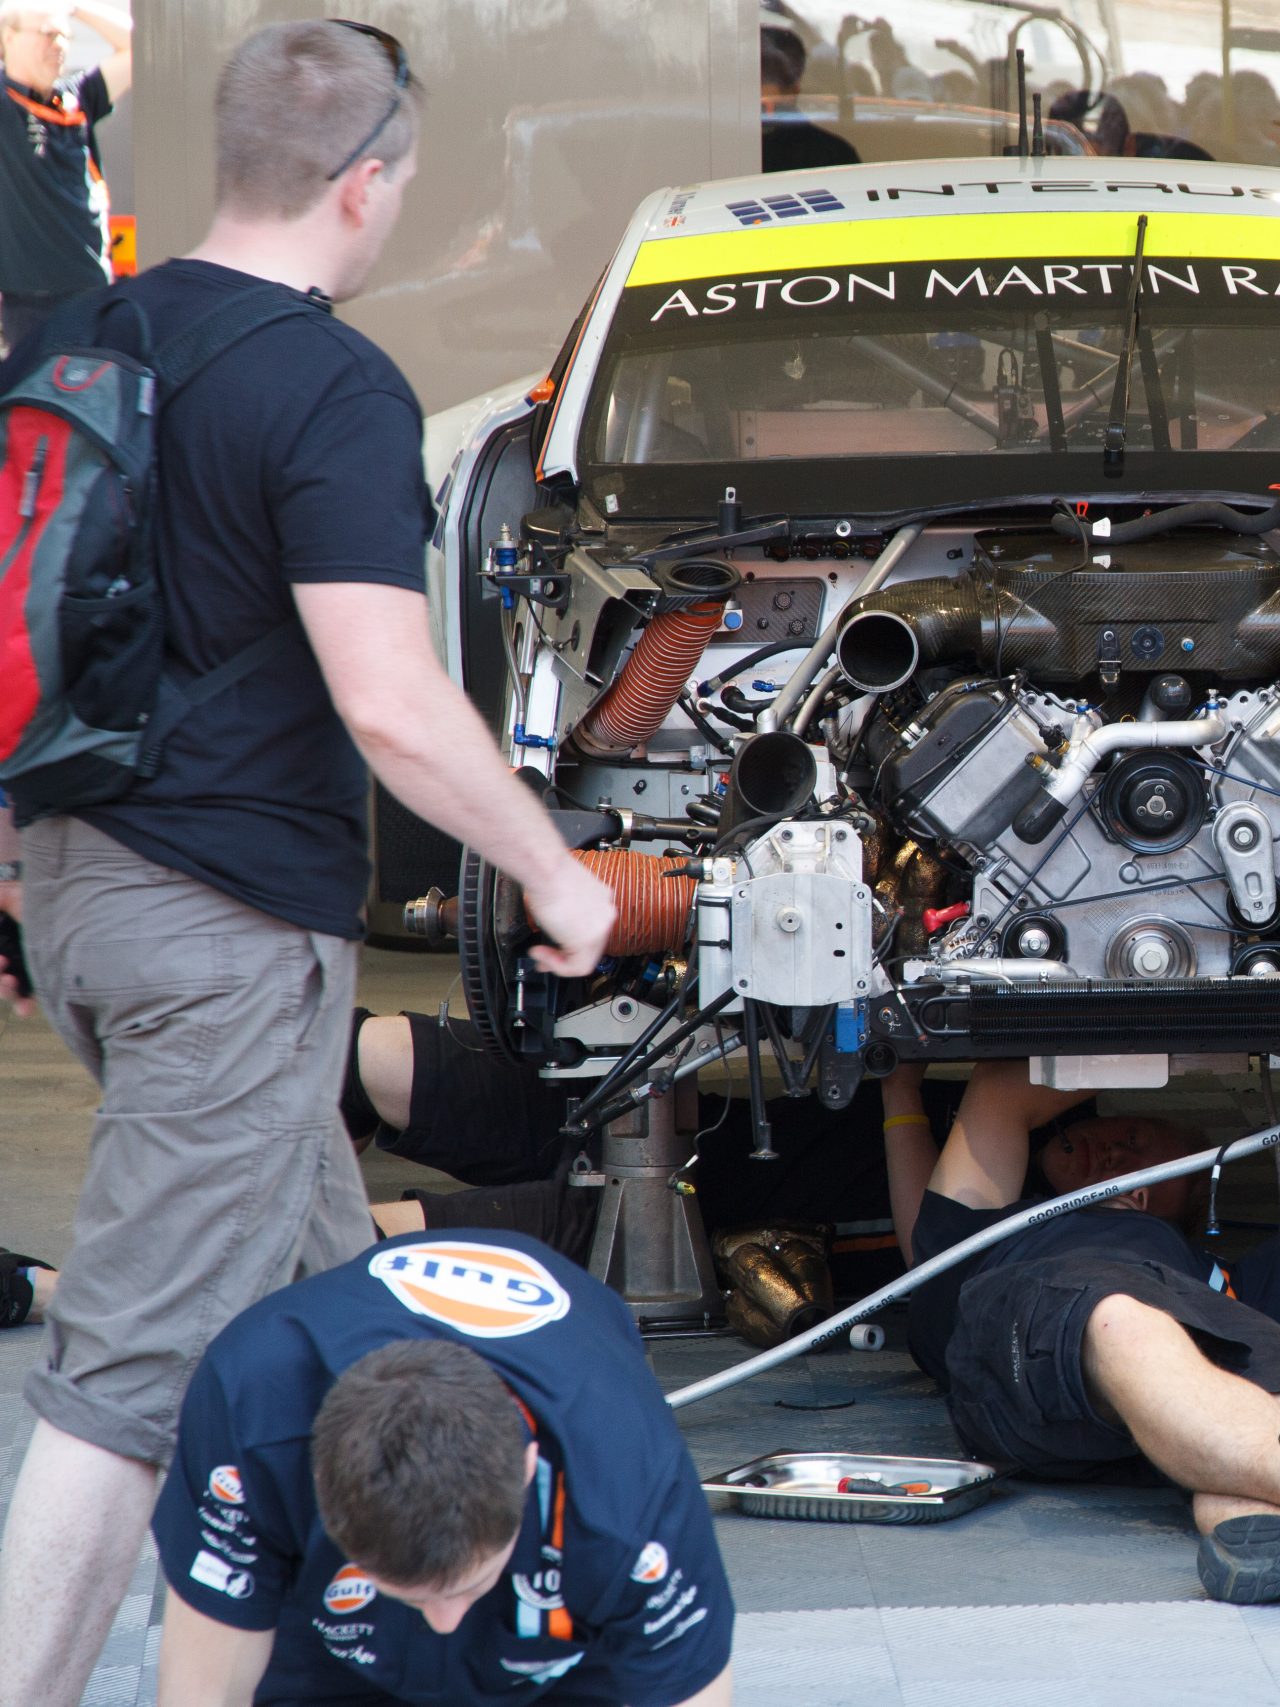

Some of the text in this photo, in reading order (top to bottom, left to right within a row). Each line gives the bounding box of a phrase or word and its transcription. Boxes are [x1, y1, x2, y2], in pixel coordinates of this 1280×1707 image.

[650, 271, 895, 322] ASTON
[1028, 1184, 1120, 1224] GOODRIDGE-08
[384, 1255, 555, 1307] Gulf
[327, 1583, 373, 1599] Gulf
